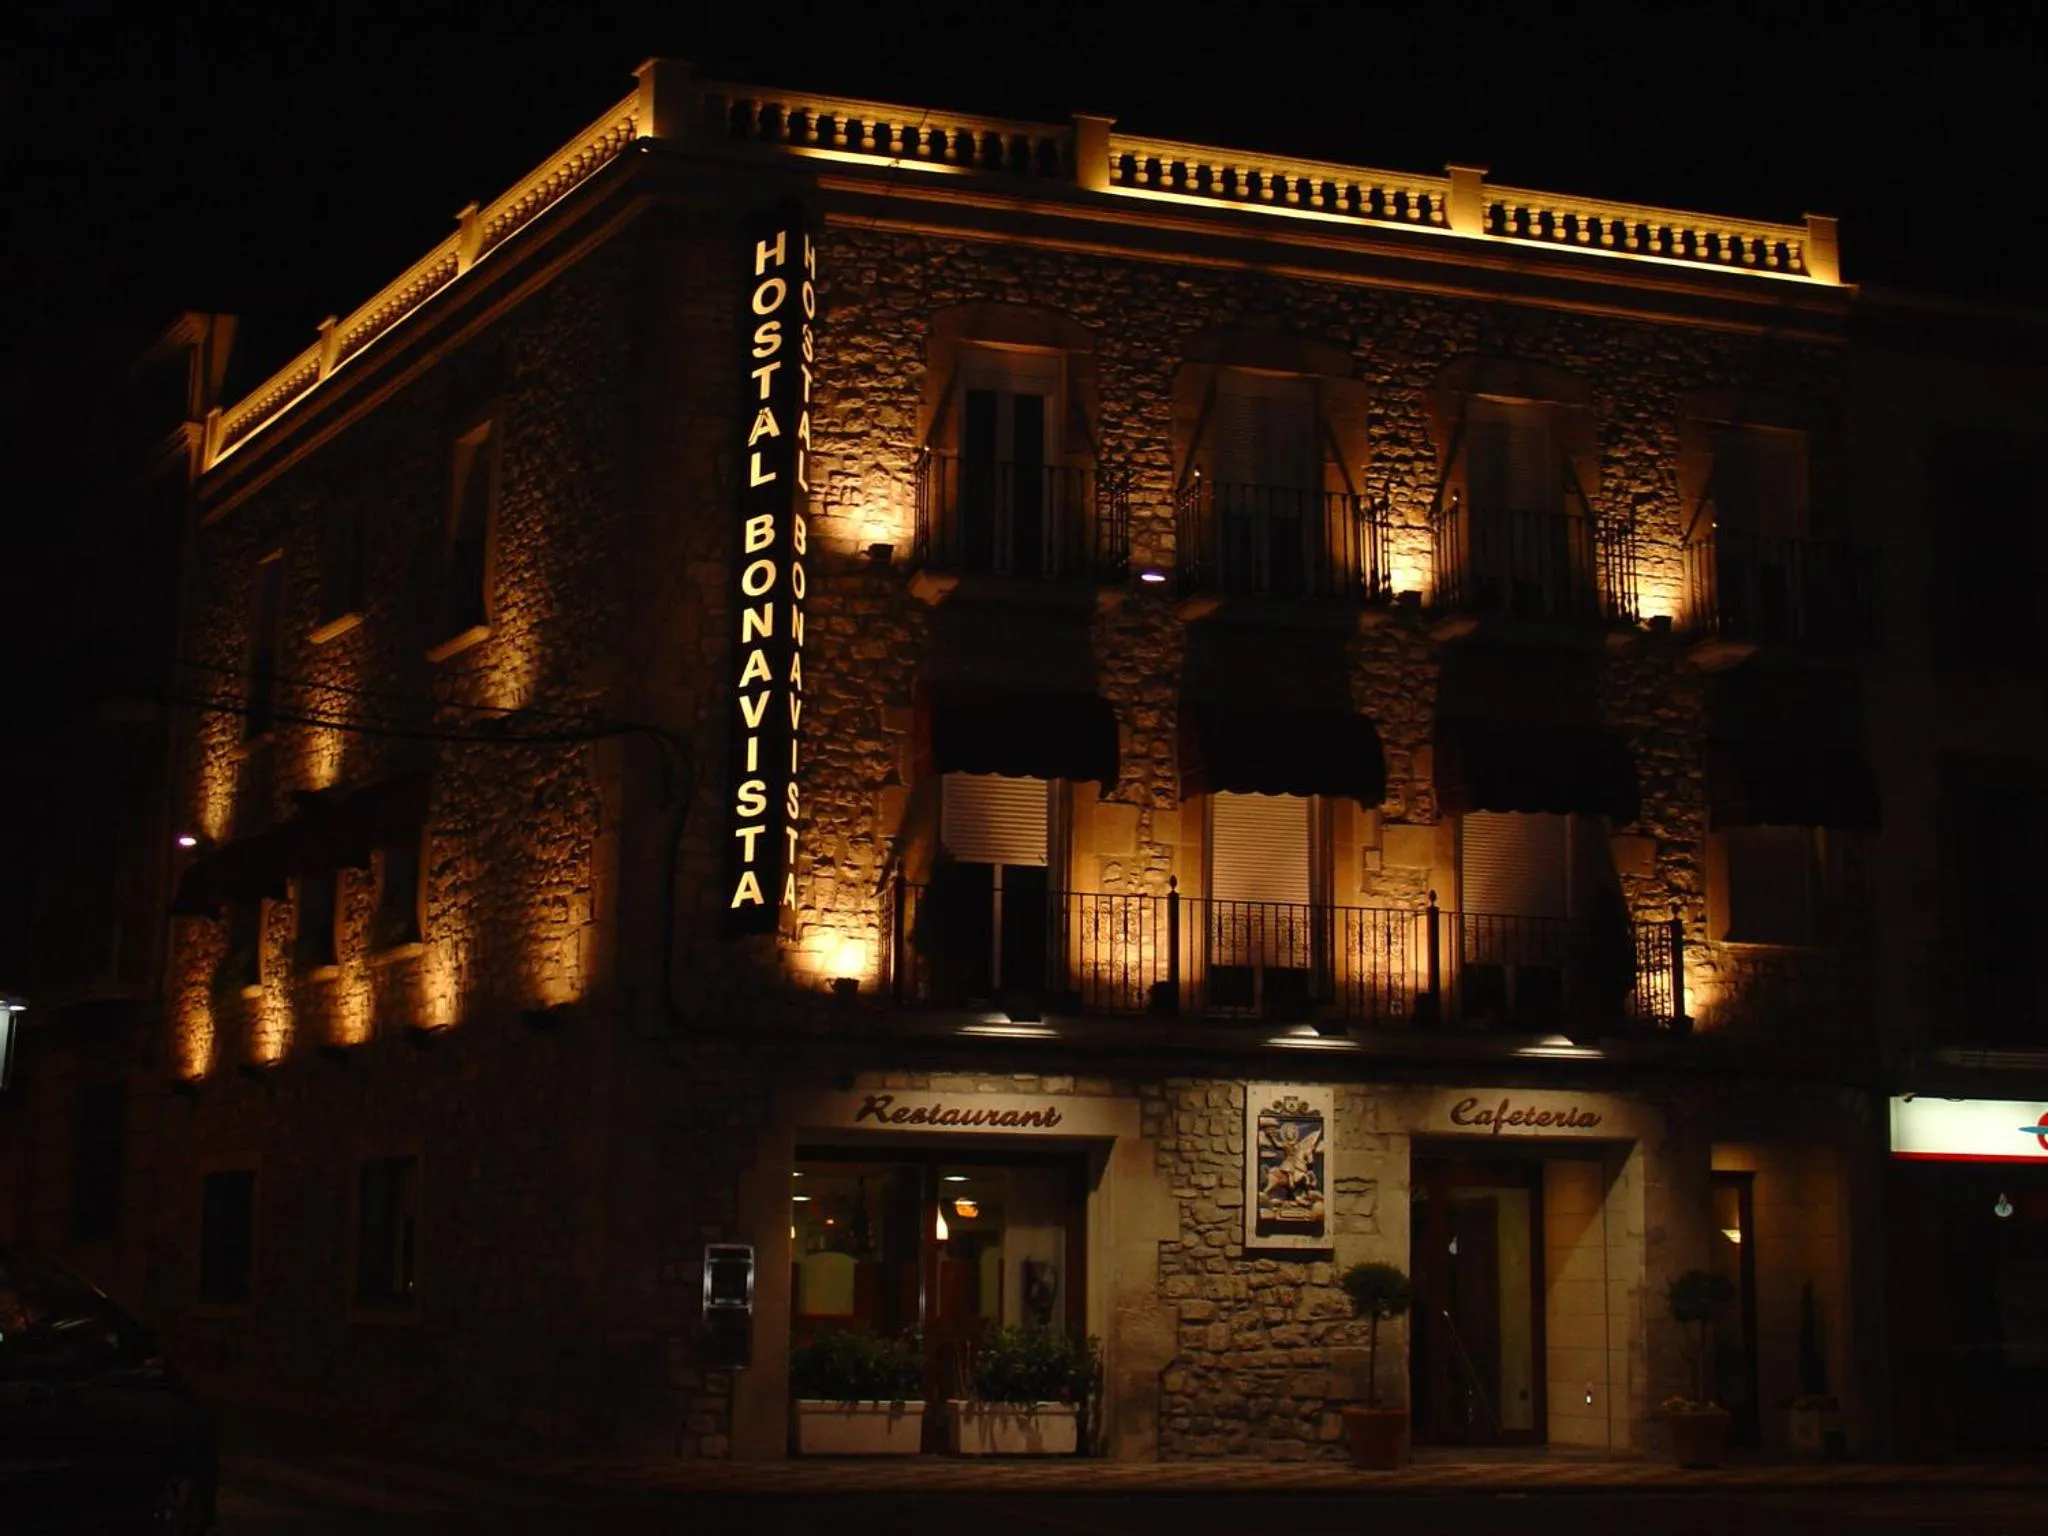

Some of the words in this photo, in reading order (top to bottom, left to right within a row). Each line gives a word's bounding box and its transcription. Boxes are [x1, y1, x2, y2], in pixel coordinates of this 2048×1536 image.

[748, 231, 787, 488] HOSTAL
[798, 233, 816, 493] HOSTAL
[731, 512, 776, 909] BONAVISTA
[783, 513, 807, 911] BONAVISTA
[855, 1094, 1063, 1128] Restaurant
[1450, 1097, 1602, 1134] Cafeteria
